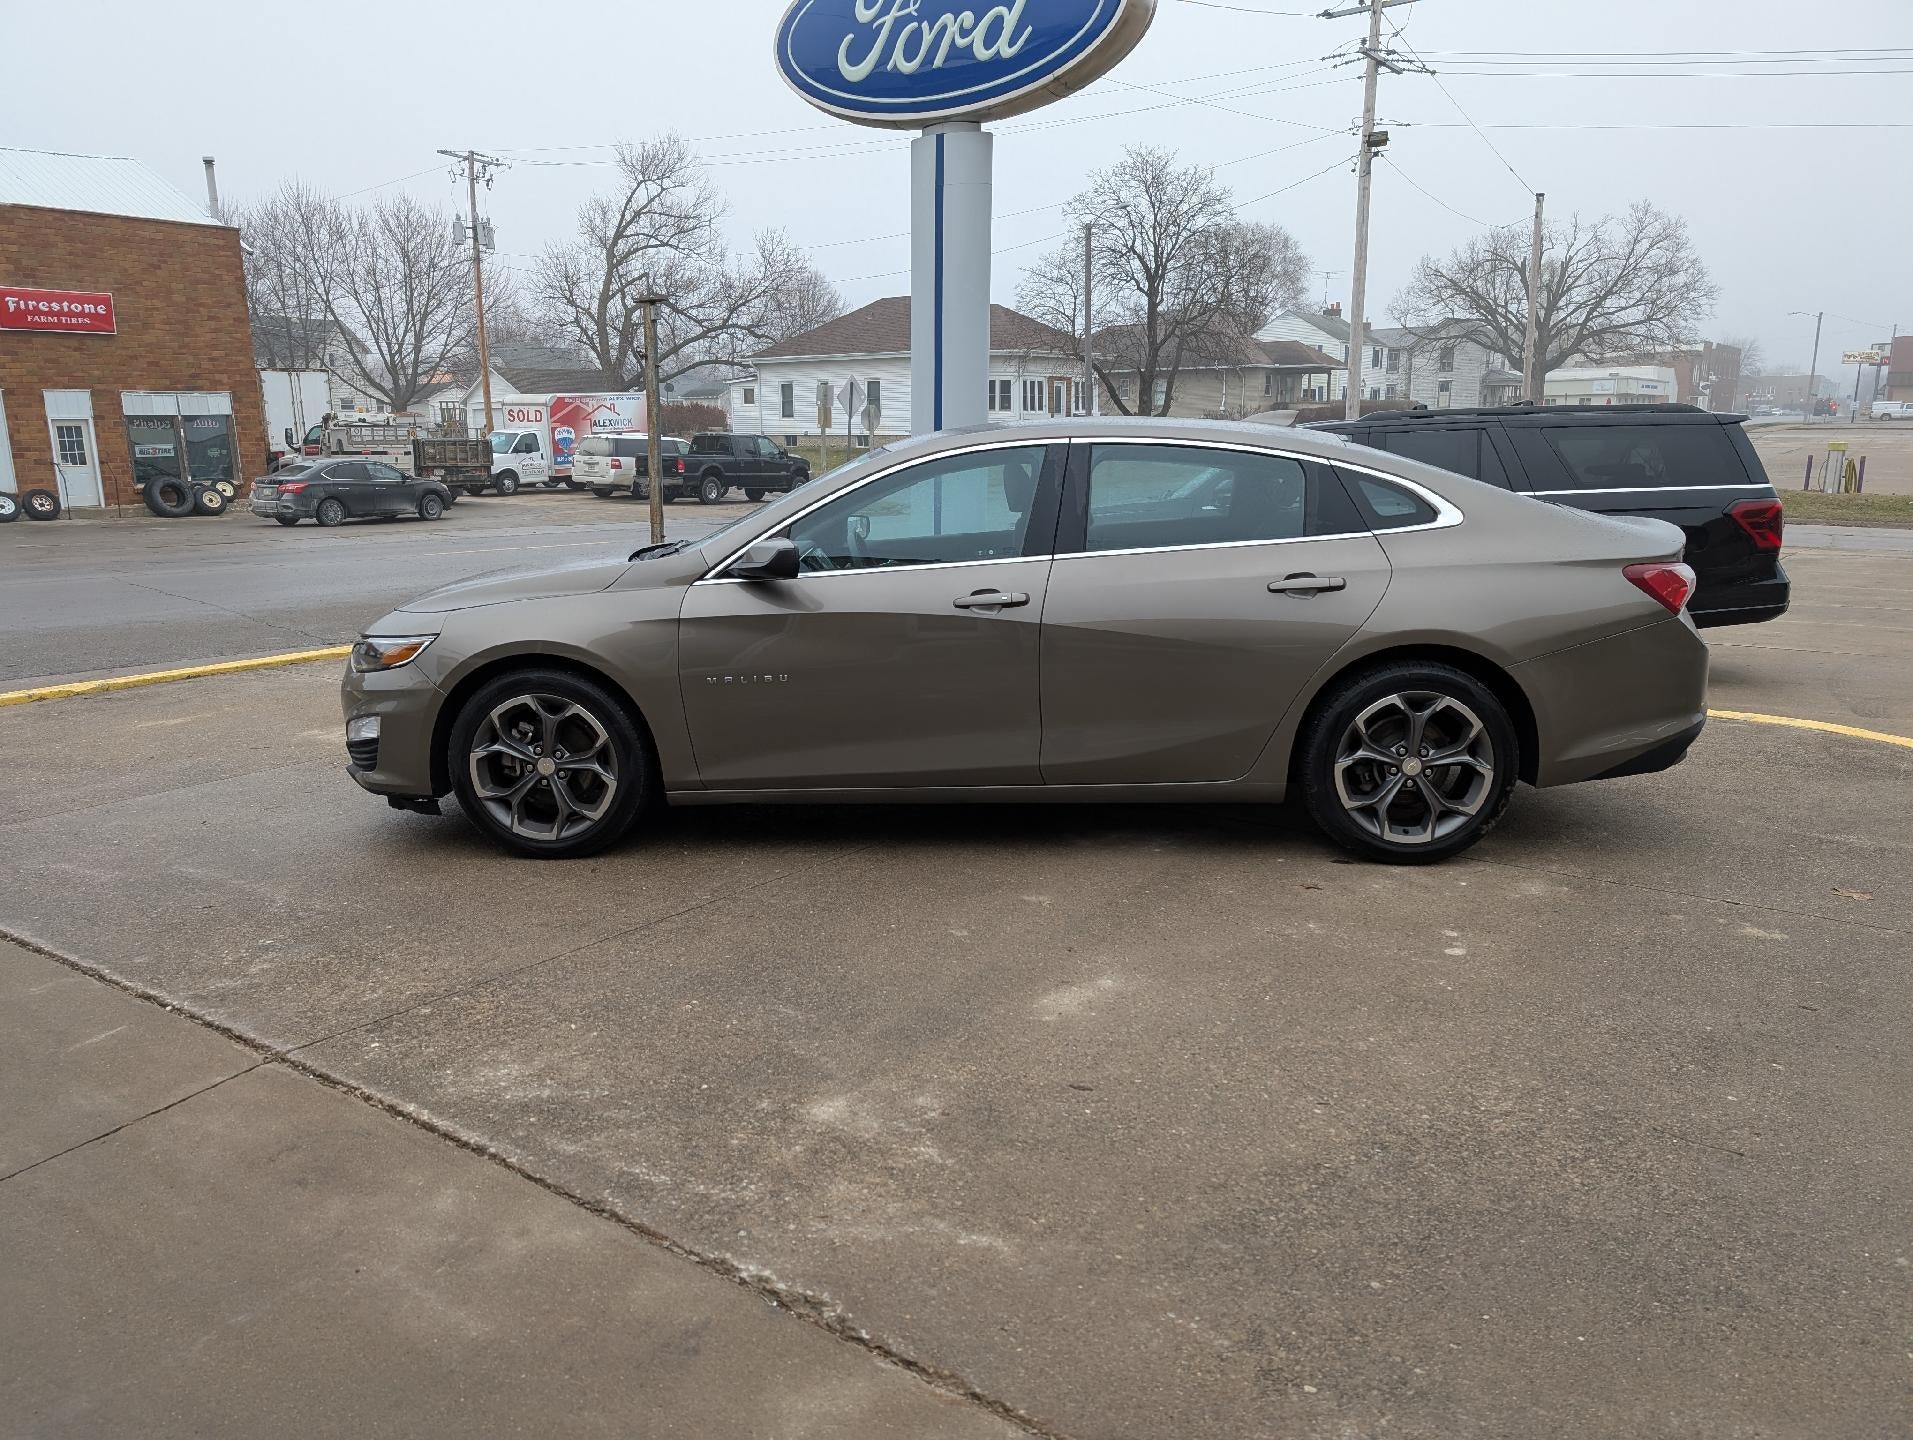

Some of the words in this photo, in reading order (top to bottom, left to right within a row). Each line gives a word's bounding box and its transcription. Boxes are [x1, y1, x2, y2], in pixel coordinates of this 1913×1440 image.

[838, 0, 1033, 82] Ford
[5, 297, 107, 314] Firestone
[27, 315, 58, 323] FARM
[60, 316, 91, 324] TIRES
[507, 408, 543, 423] SOLD
[706, 674, 788, 684] MALIBU
